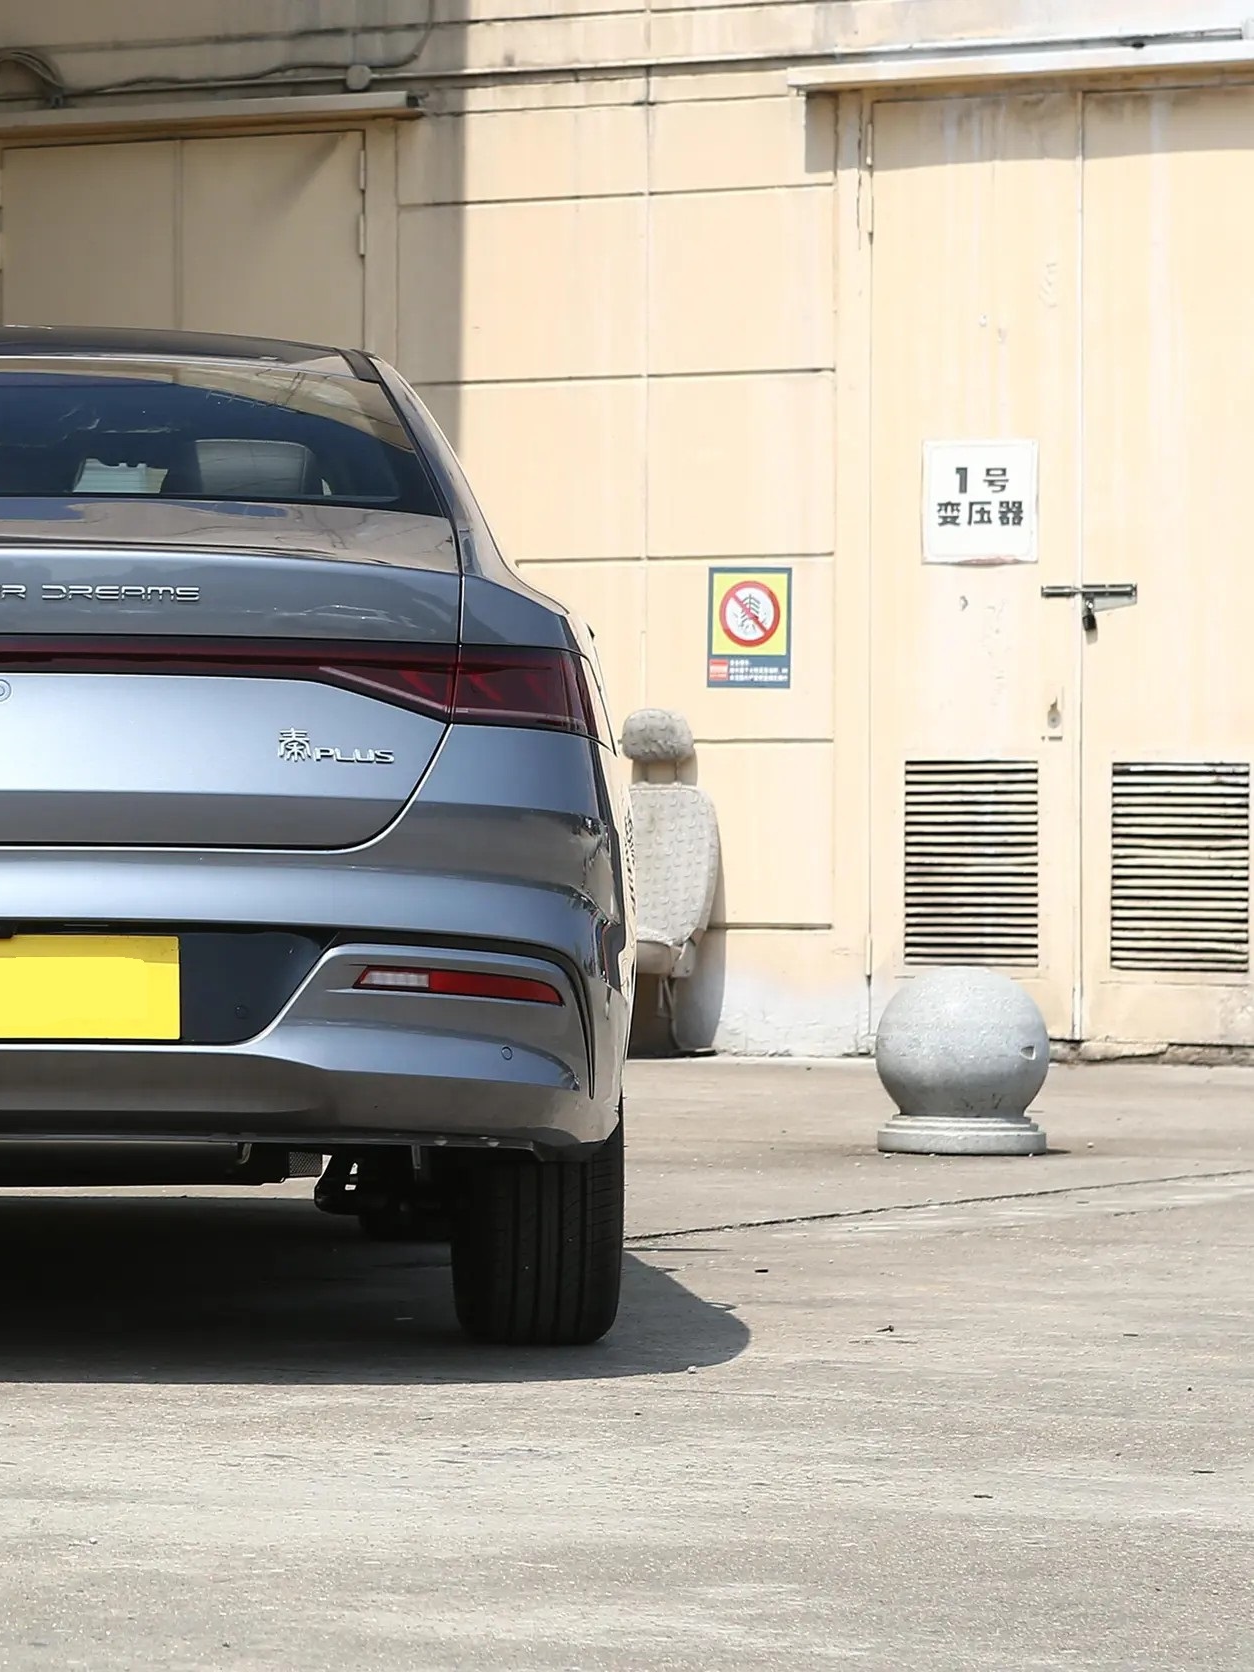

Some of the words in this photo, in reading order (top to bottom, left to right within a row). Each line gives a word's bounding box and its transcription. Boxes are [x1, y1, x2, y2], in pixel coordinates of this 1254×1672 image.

[937, 501, 1023, 527] 变压器
[42, 584, 201, 602] DREAMS
